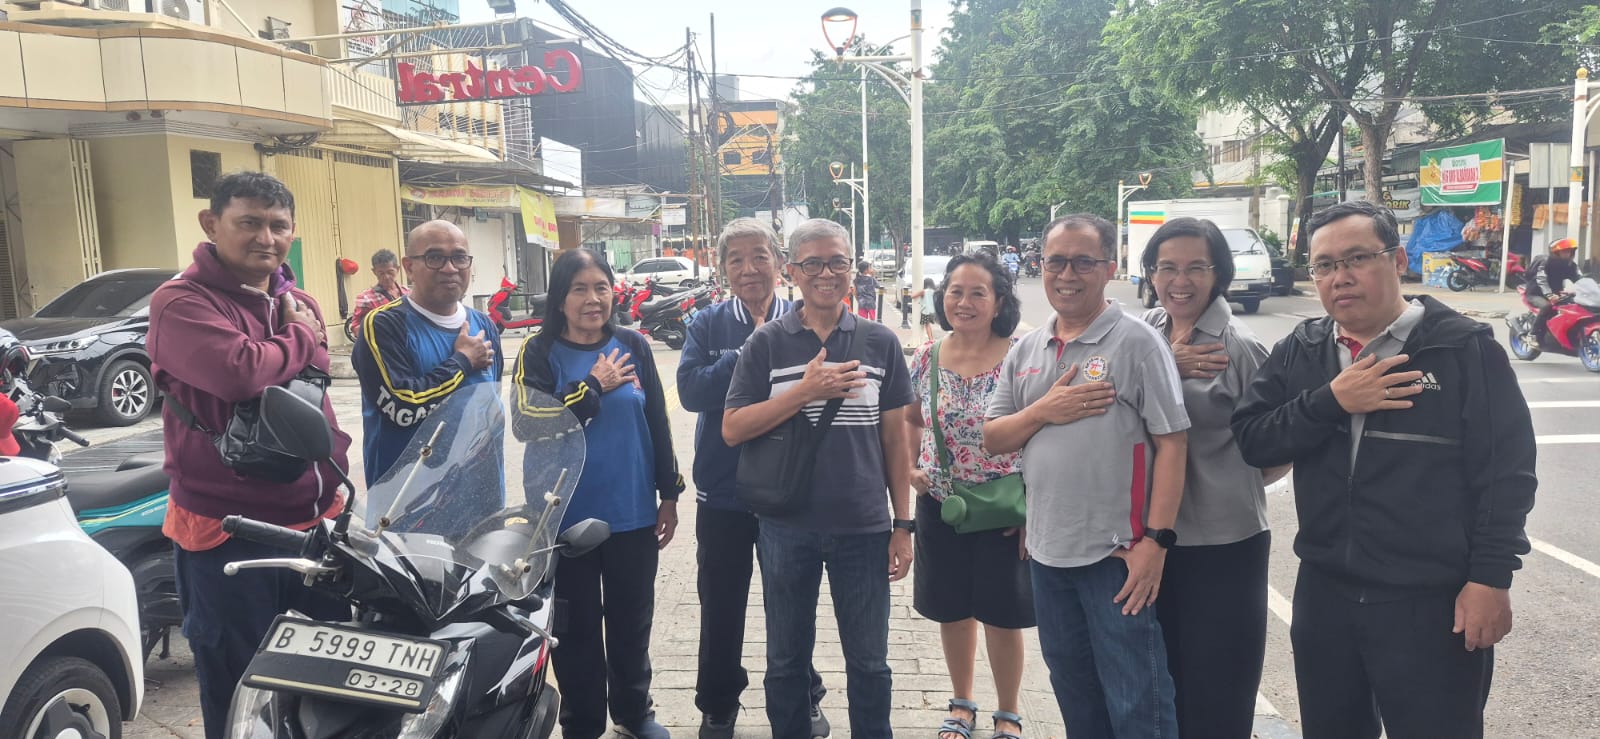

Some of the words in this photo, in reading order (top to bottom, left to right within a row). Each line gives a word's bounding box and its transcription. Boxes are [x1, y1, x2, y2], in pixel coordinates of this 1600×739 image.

[1411, 382, 1441, 391] idas
[275, 627, 296, 649] B
[309, 631, 376, 661] 5999
[387, 642, 437, 672] TNH
